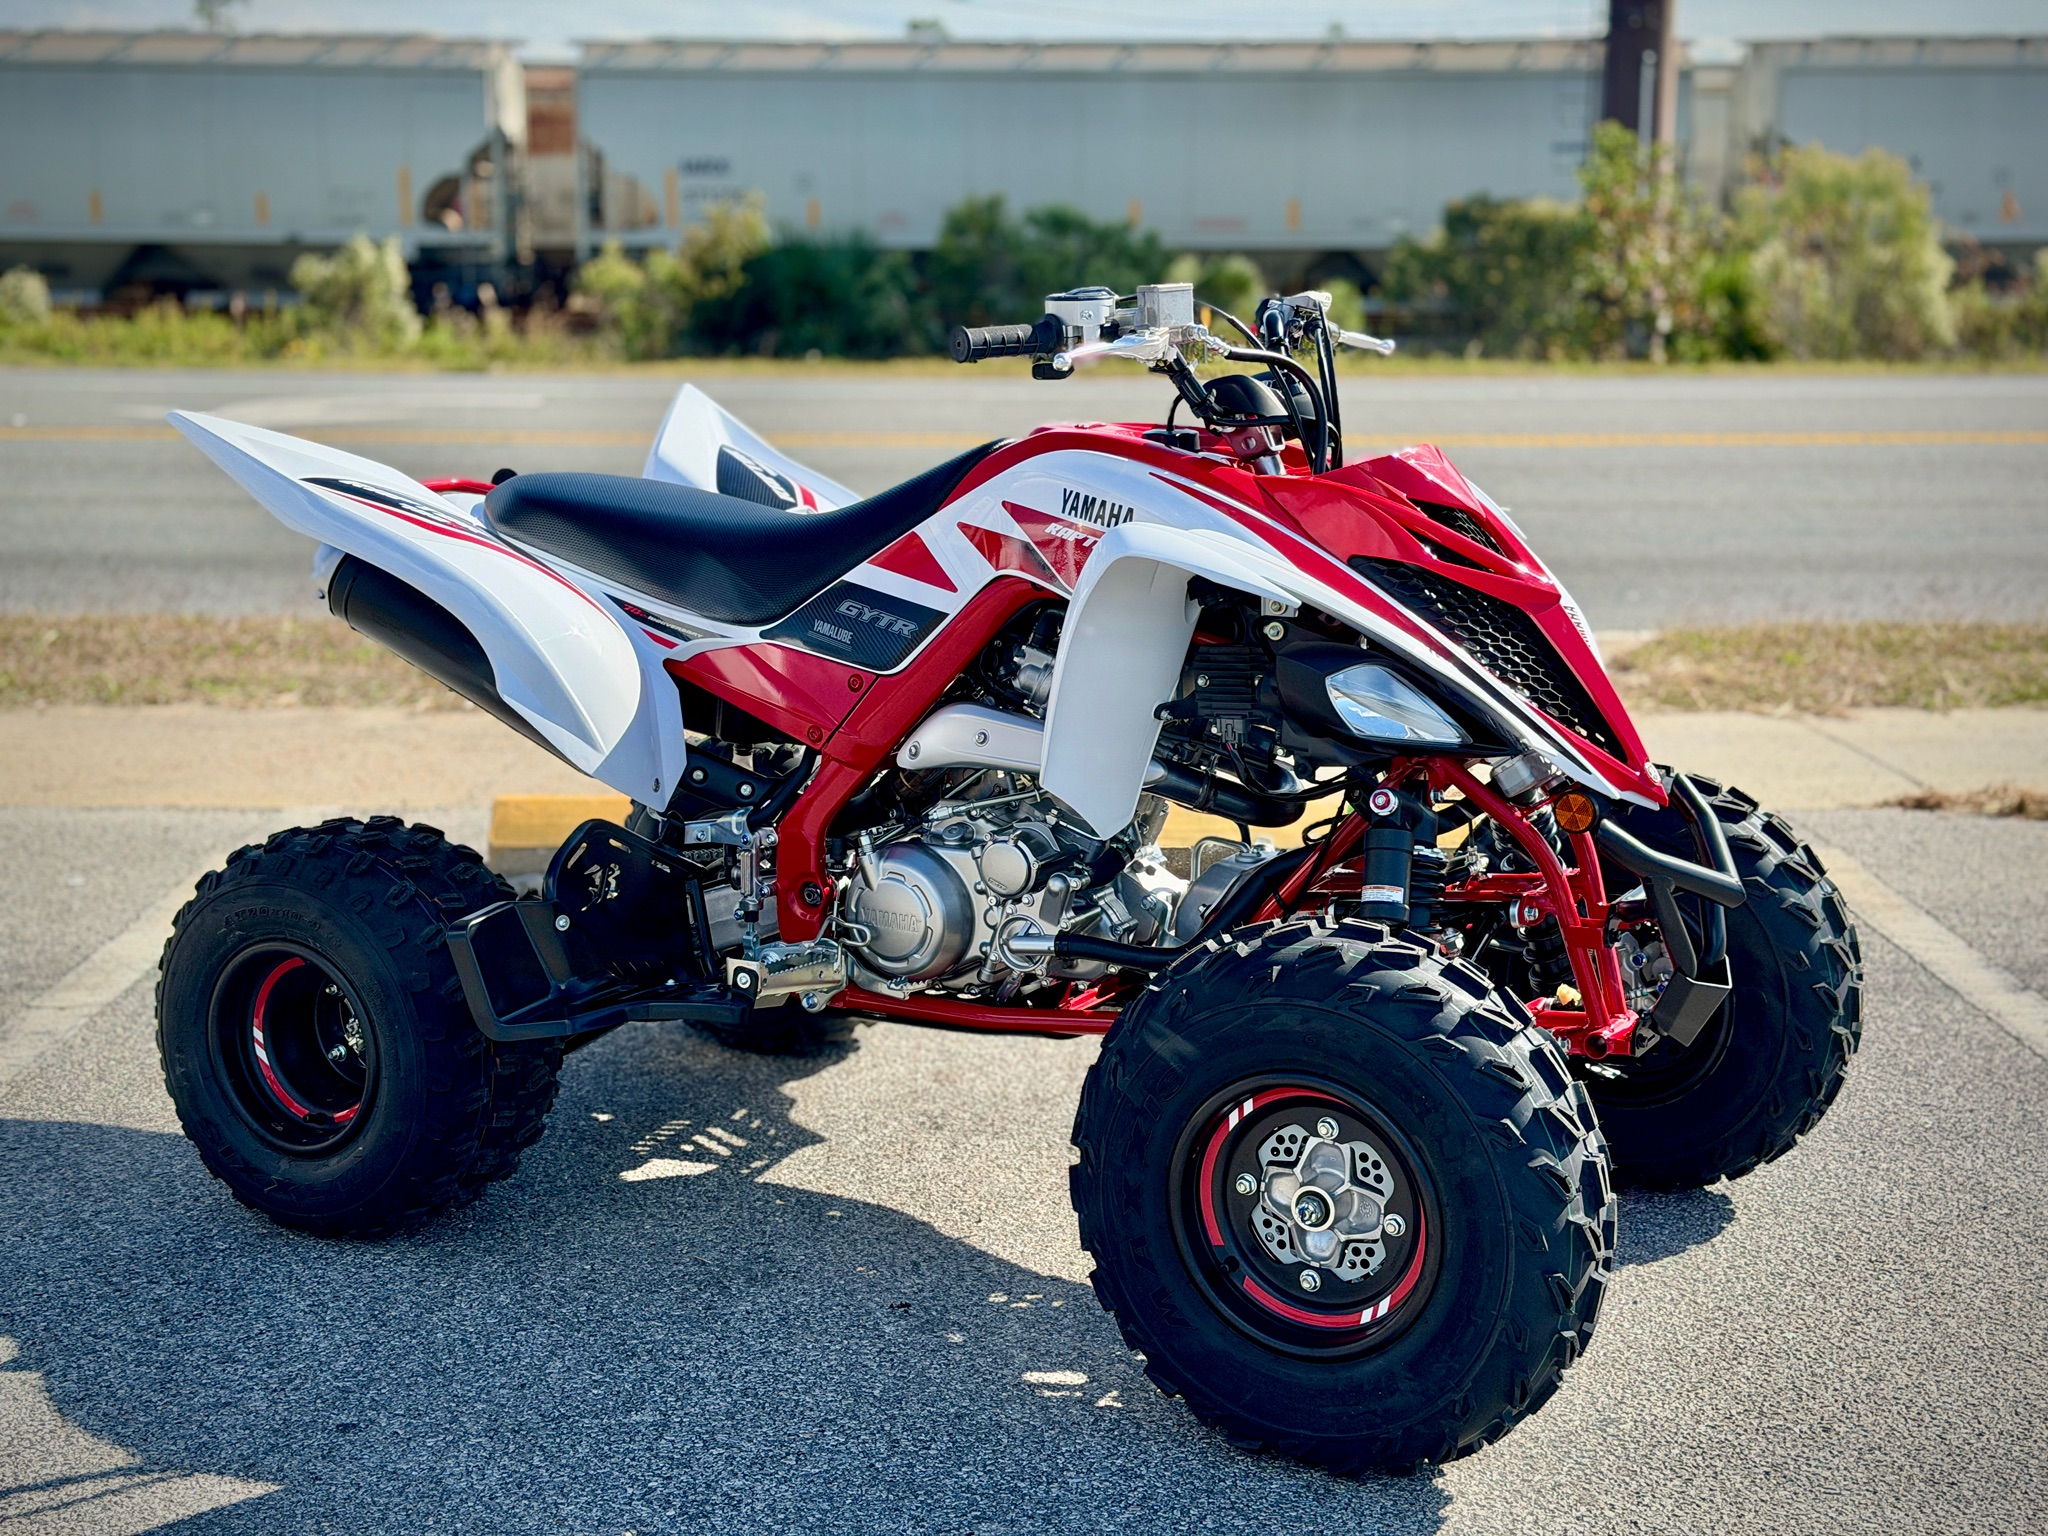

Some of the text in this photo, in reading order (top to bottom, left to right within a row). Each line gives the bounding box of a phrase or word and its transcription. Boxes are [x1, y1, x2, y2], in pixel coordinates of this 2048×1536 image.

[1061, 487, 1135, 528] YAMAHA
[1044, 522, 1100, 549] RAPT
[646, 614, 704, 639] ANNIVERSARY
[813, 618, 854, 645] YAMALUBE
[836, 598, 919, 639] GYTR
[860, 906, 920, 933] YAMAHA
